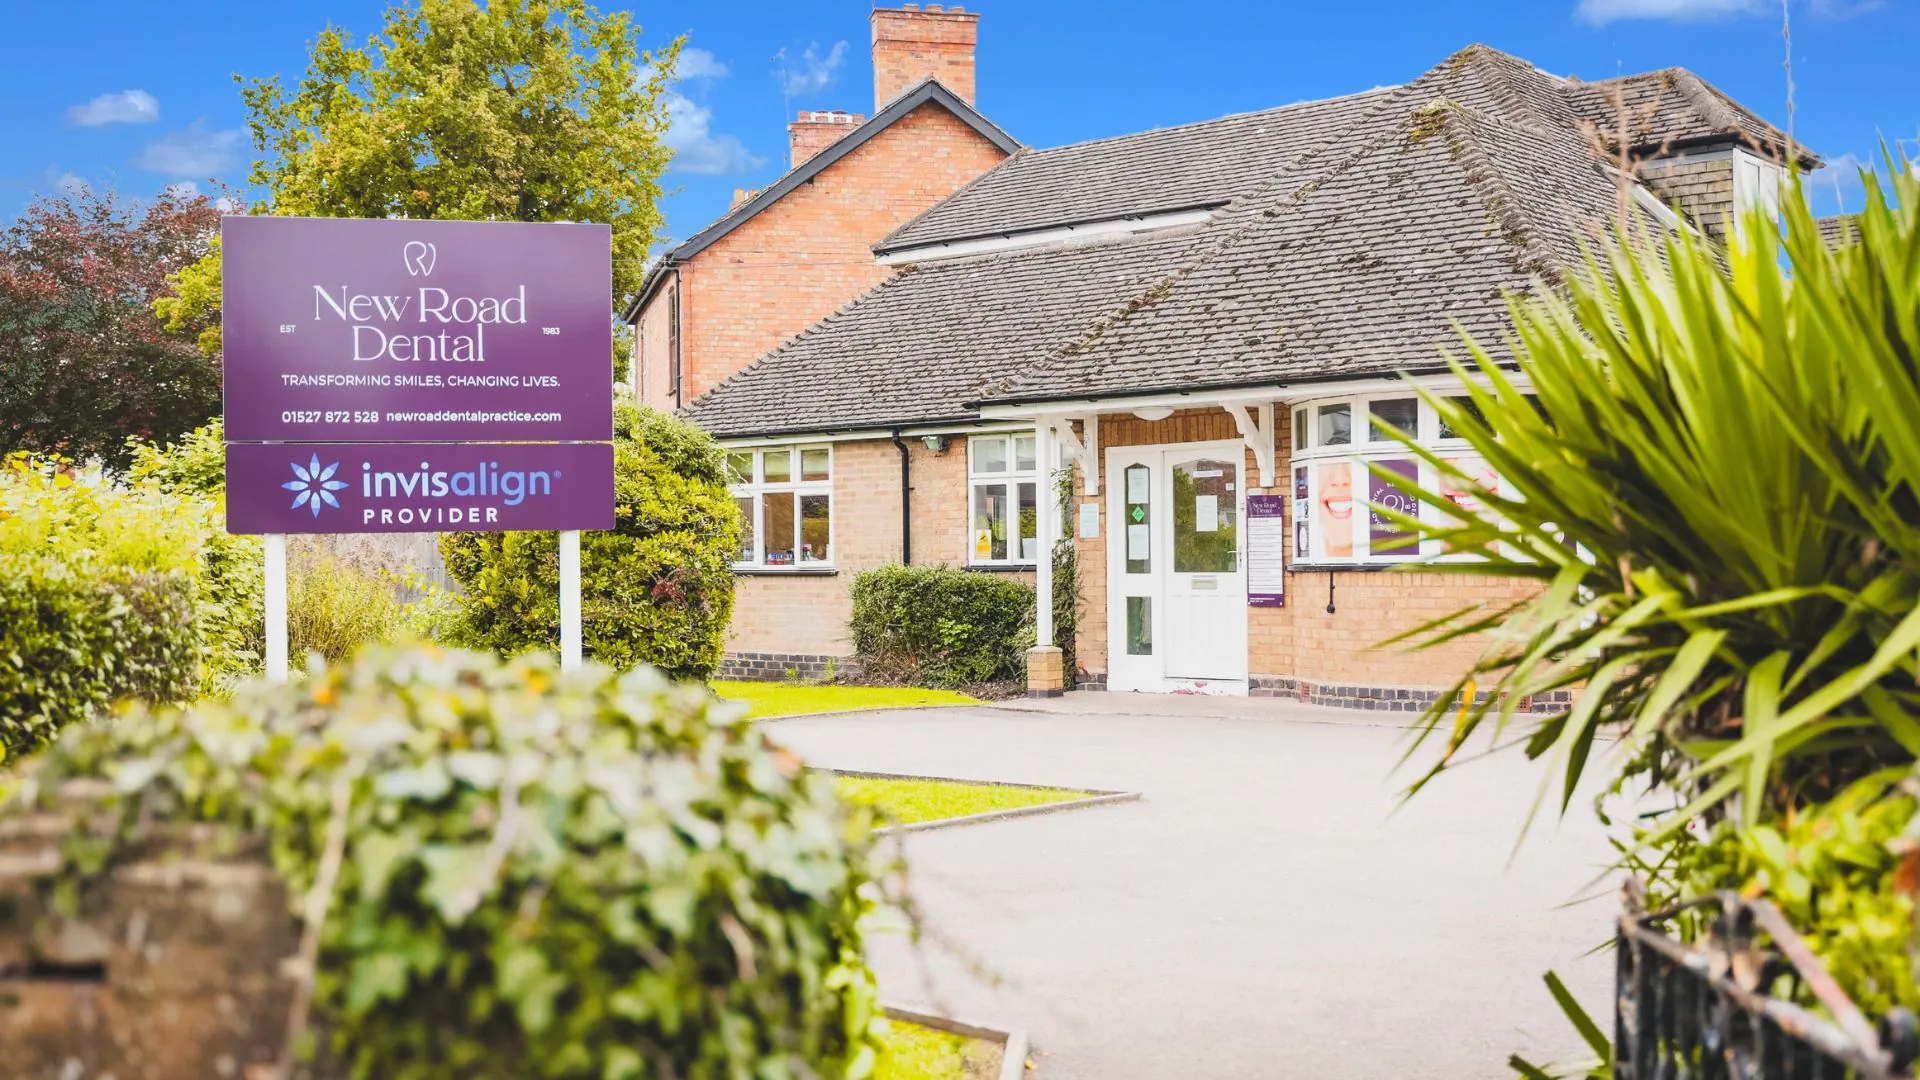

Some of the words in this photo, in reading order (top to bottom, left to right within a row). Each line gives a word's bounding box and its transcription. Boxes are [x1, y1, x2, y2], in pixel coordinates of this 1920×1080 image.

[312, 284, 411, 321] New
[418, 284, 528, 324] Road
[279, 324, 297, 333] EST
[542, 326, 561, 336] 1983
[351, 323, 485, 362] Dental
[281, 374, 391, 388] TRANSFORMING
[393, 375, 445, 389] SMILES,
[447, 375, 520, 388] CHANGING
[522, 376, 561, 388] LIVES.
[281, 411, 322, 424] 01527
[324, 411, 351, 424] 872
[353, 411, 380, 424] 528
[386, 411, 562, 425] newroaddentalpractice.com
[363, 507, 498, 525] PROVIDER
